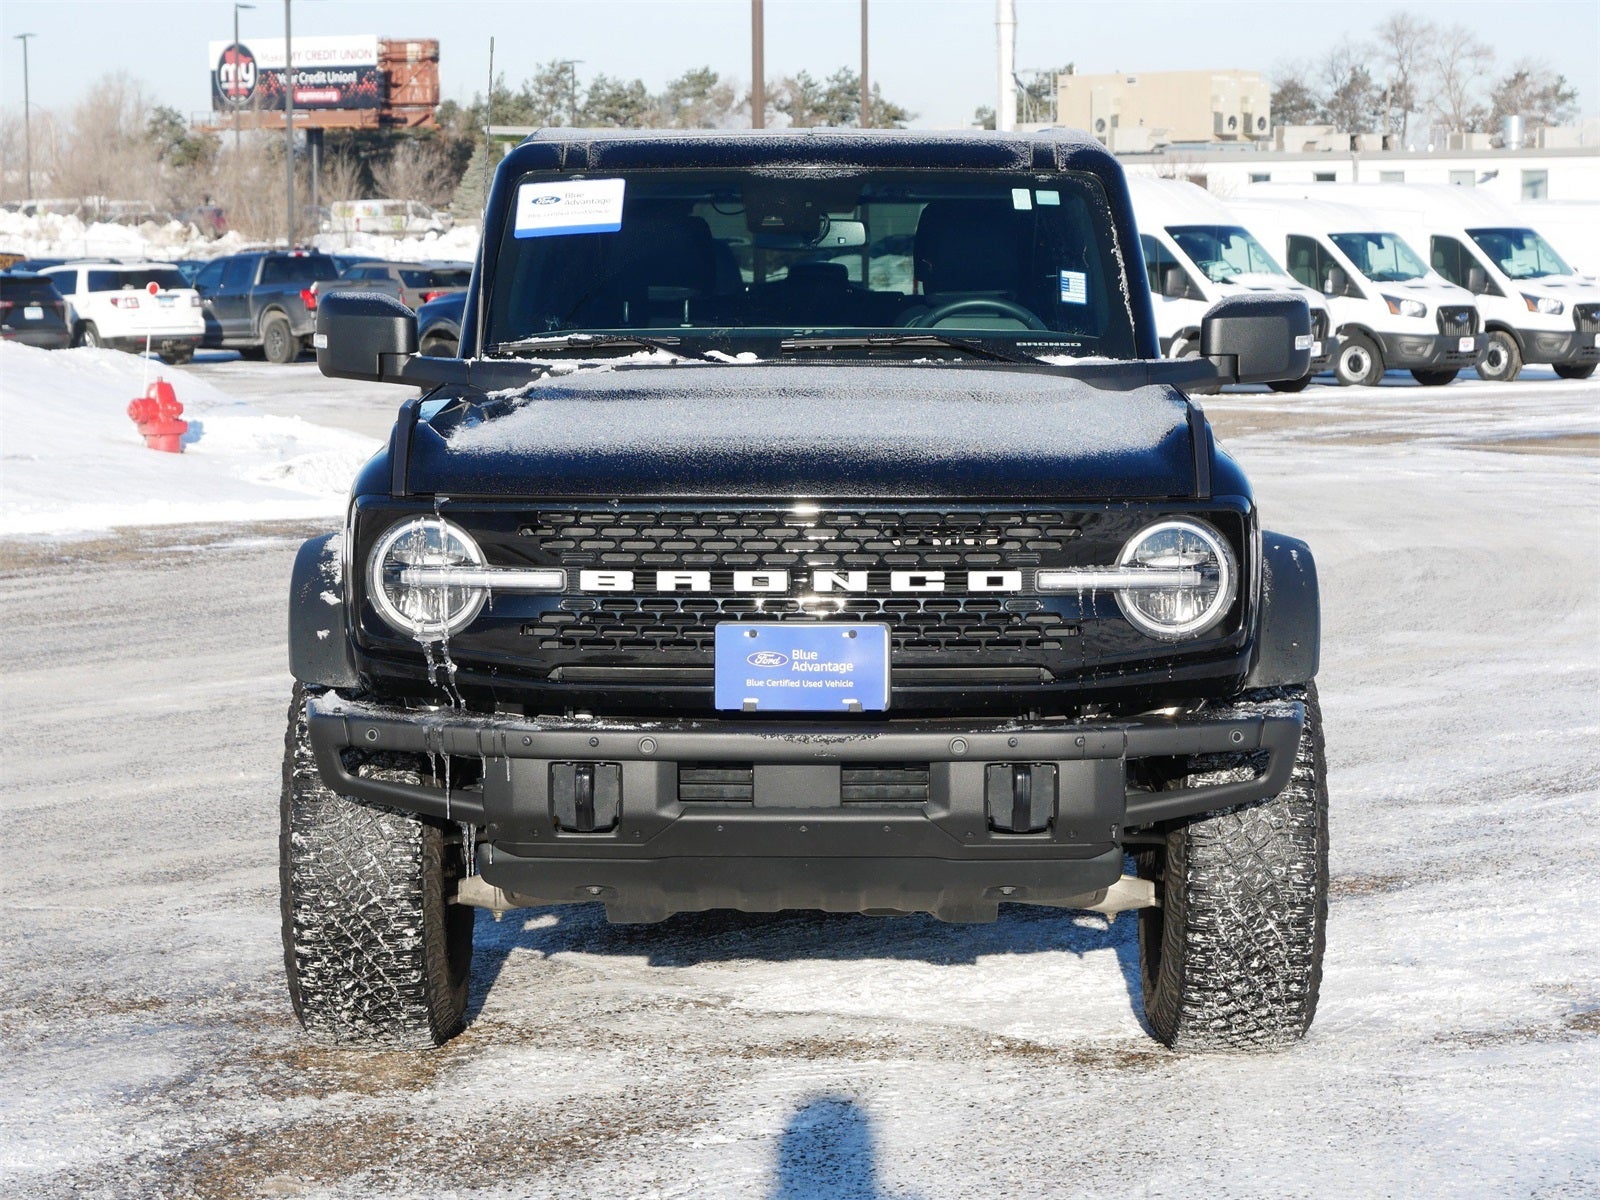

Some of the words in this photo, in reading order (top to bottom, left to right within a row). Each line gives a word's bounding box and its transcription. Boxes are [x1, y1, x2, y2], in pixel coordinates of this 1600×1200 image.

[305, 50, 336, 61] CREDIT
[340, 49, 372, 60] UNION
[220, 62, 255, 89] my
[299, 71, 326, 84] Credit
[327, 70, 357, 83] Union!
[564, 197, 612, 207] Advantage
[579, 570, 1022, 592] BRONCO
[753, 653, 781, 665] Ford
[792, 649, 818, 660] Blue
[791, 661, 854, 674] Advantage
[746, 679, 764, 687] Blue
[766, 679, 800, 687] Certified
[802, 680, 823, 688] Used
[825, 679, 854, 688] Vehicle
